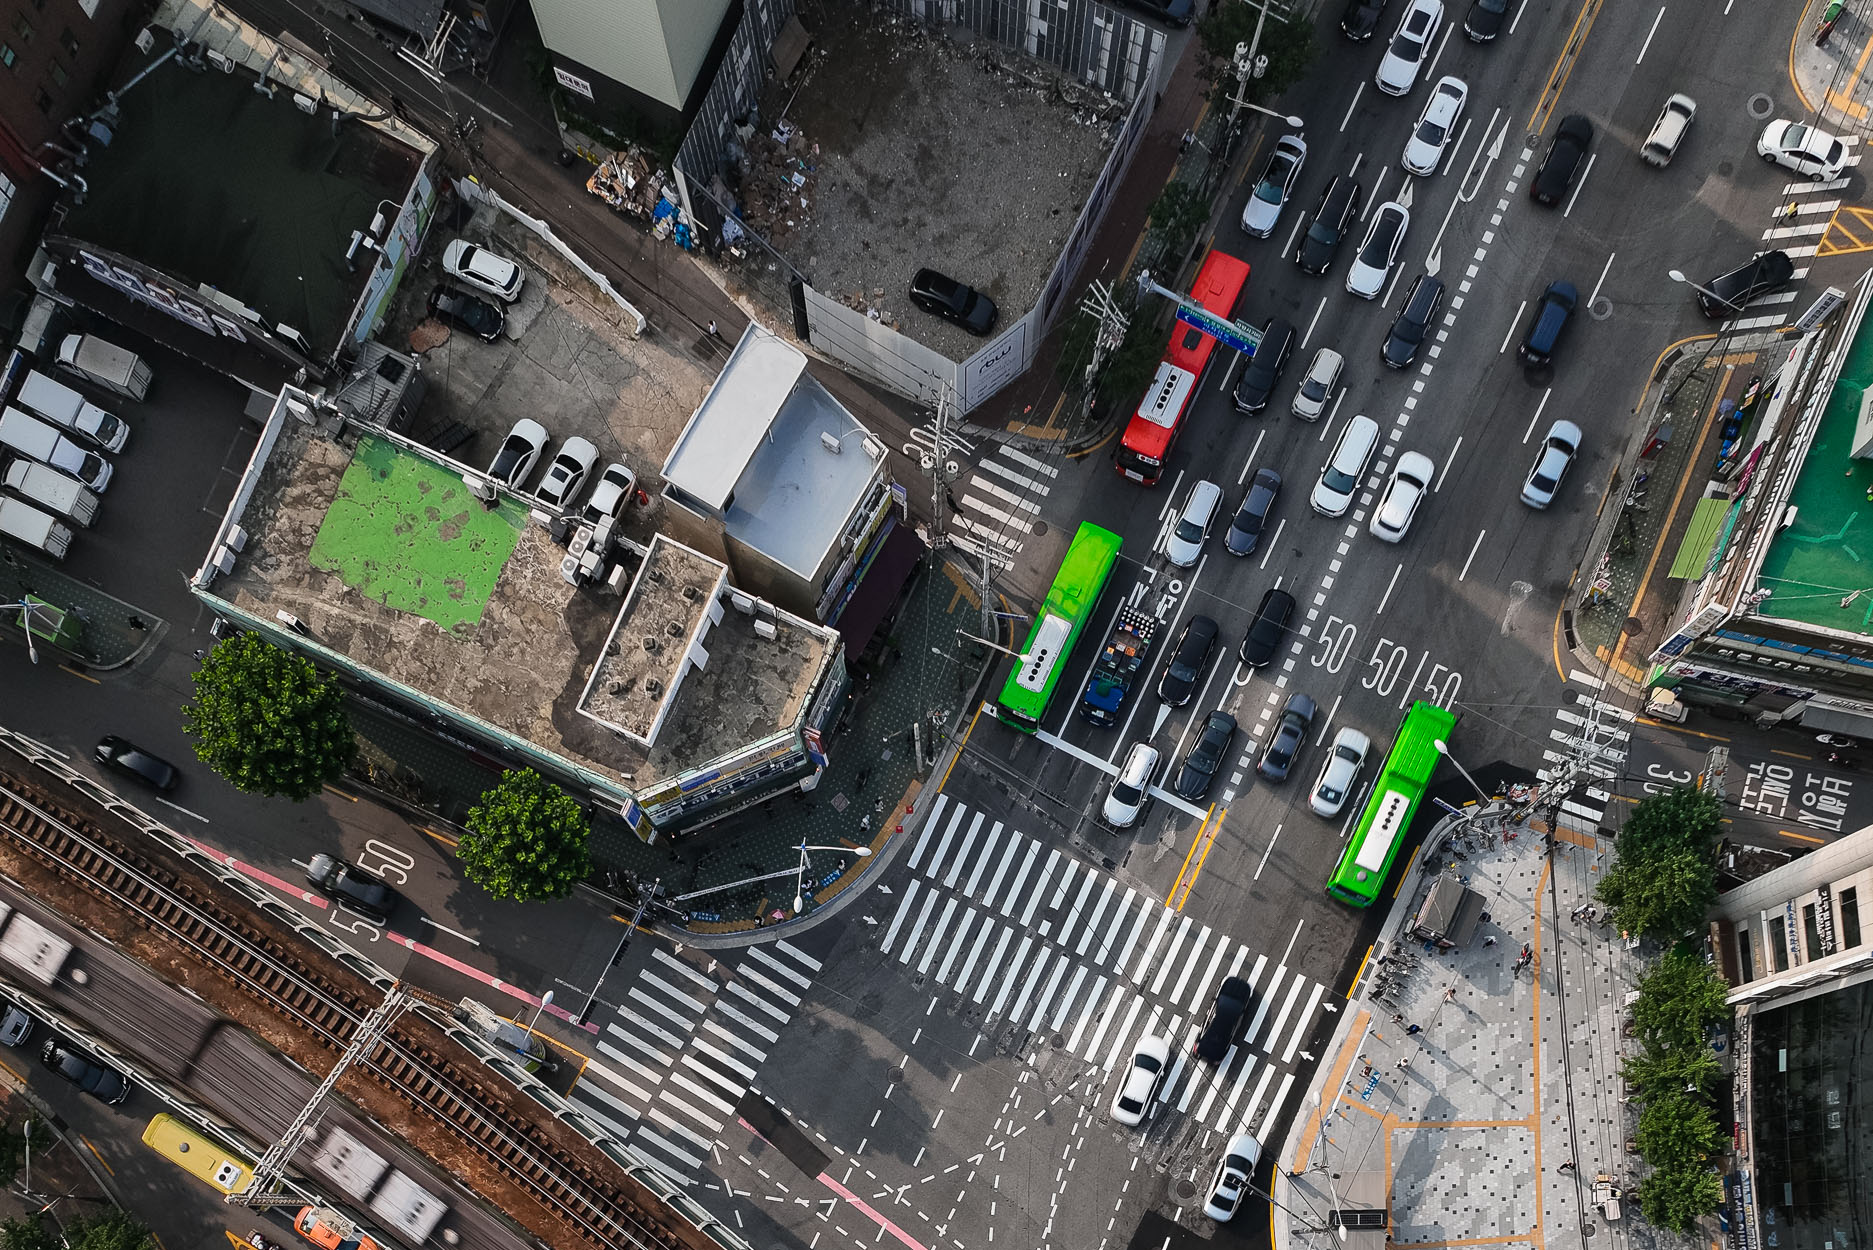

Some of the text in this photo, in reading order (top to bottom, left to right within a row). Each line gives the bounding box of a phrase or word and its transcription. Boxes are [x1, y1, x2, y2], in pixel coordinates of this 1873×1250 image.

[1311, 616, 1356, 673] 50
[1362, 638, 1408, 697] 50
[1423, 663, 1463, 707] 50
[1798, 774, 1852, 831] 보행자
[357, 840, 414, 885] 50
